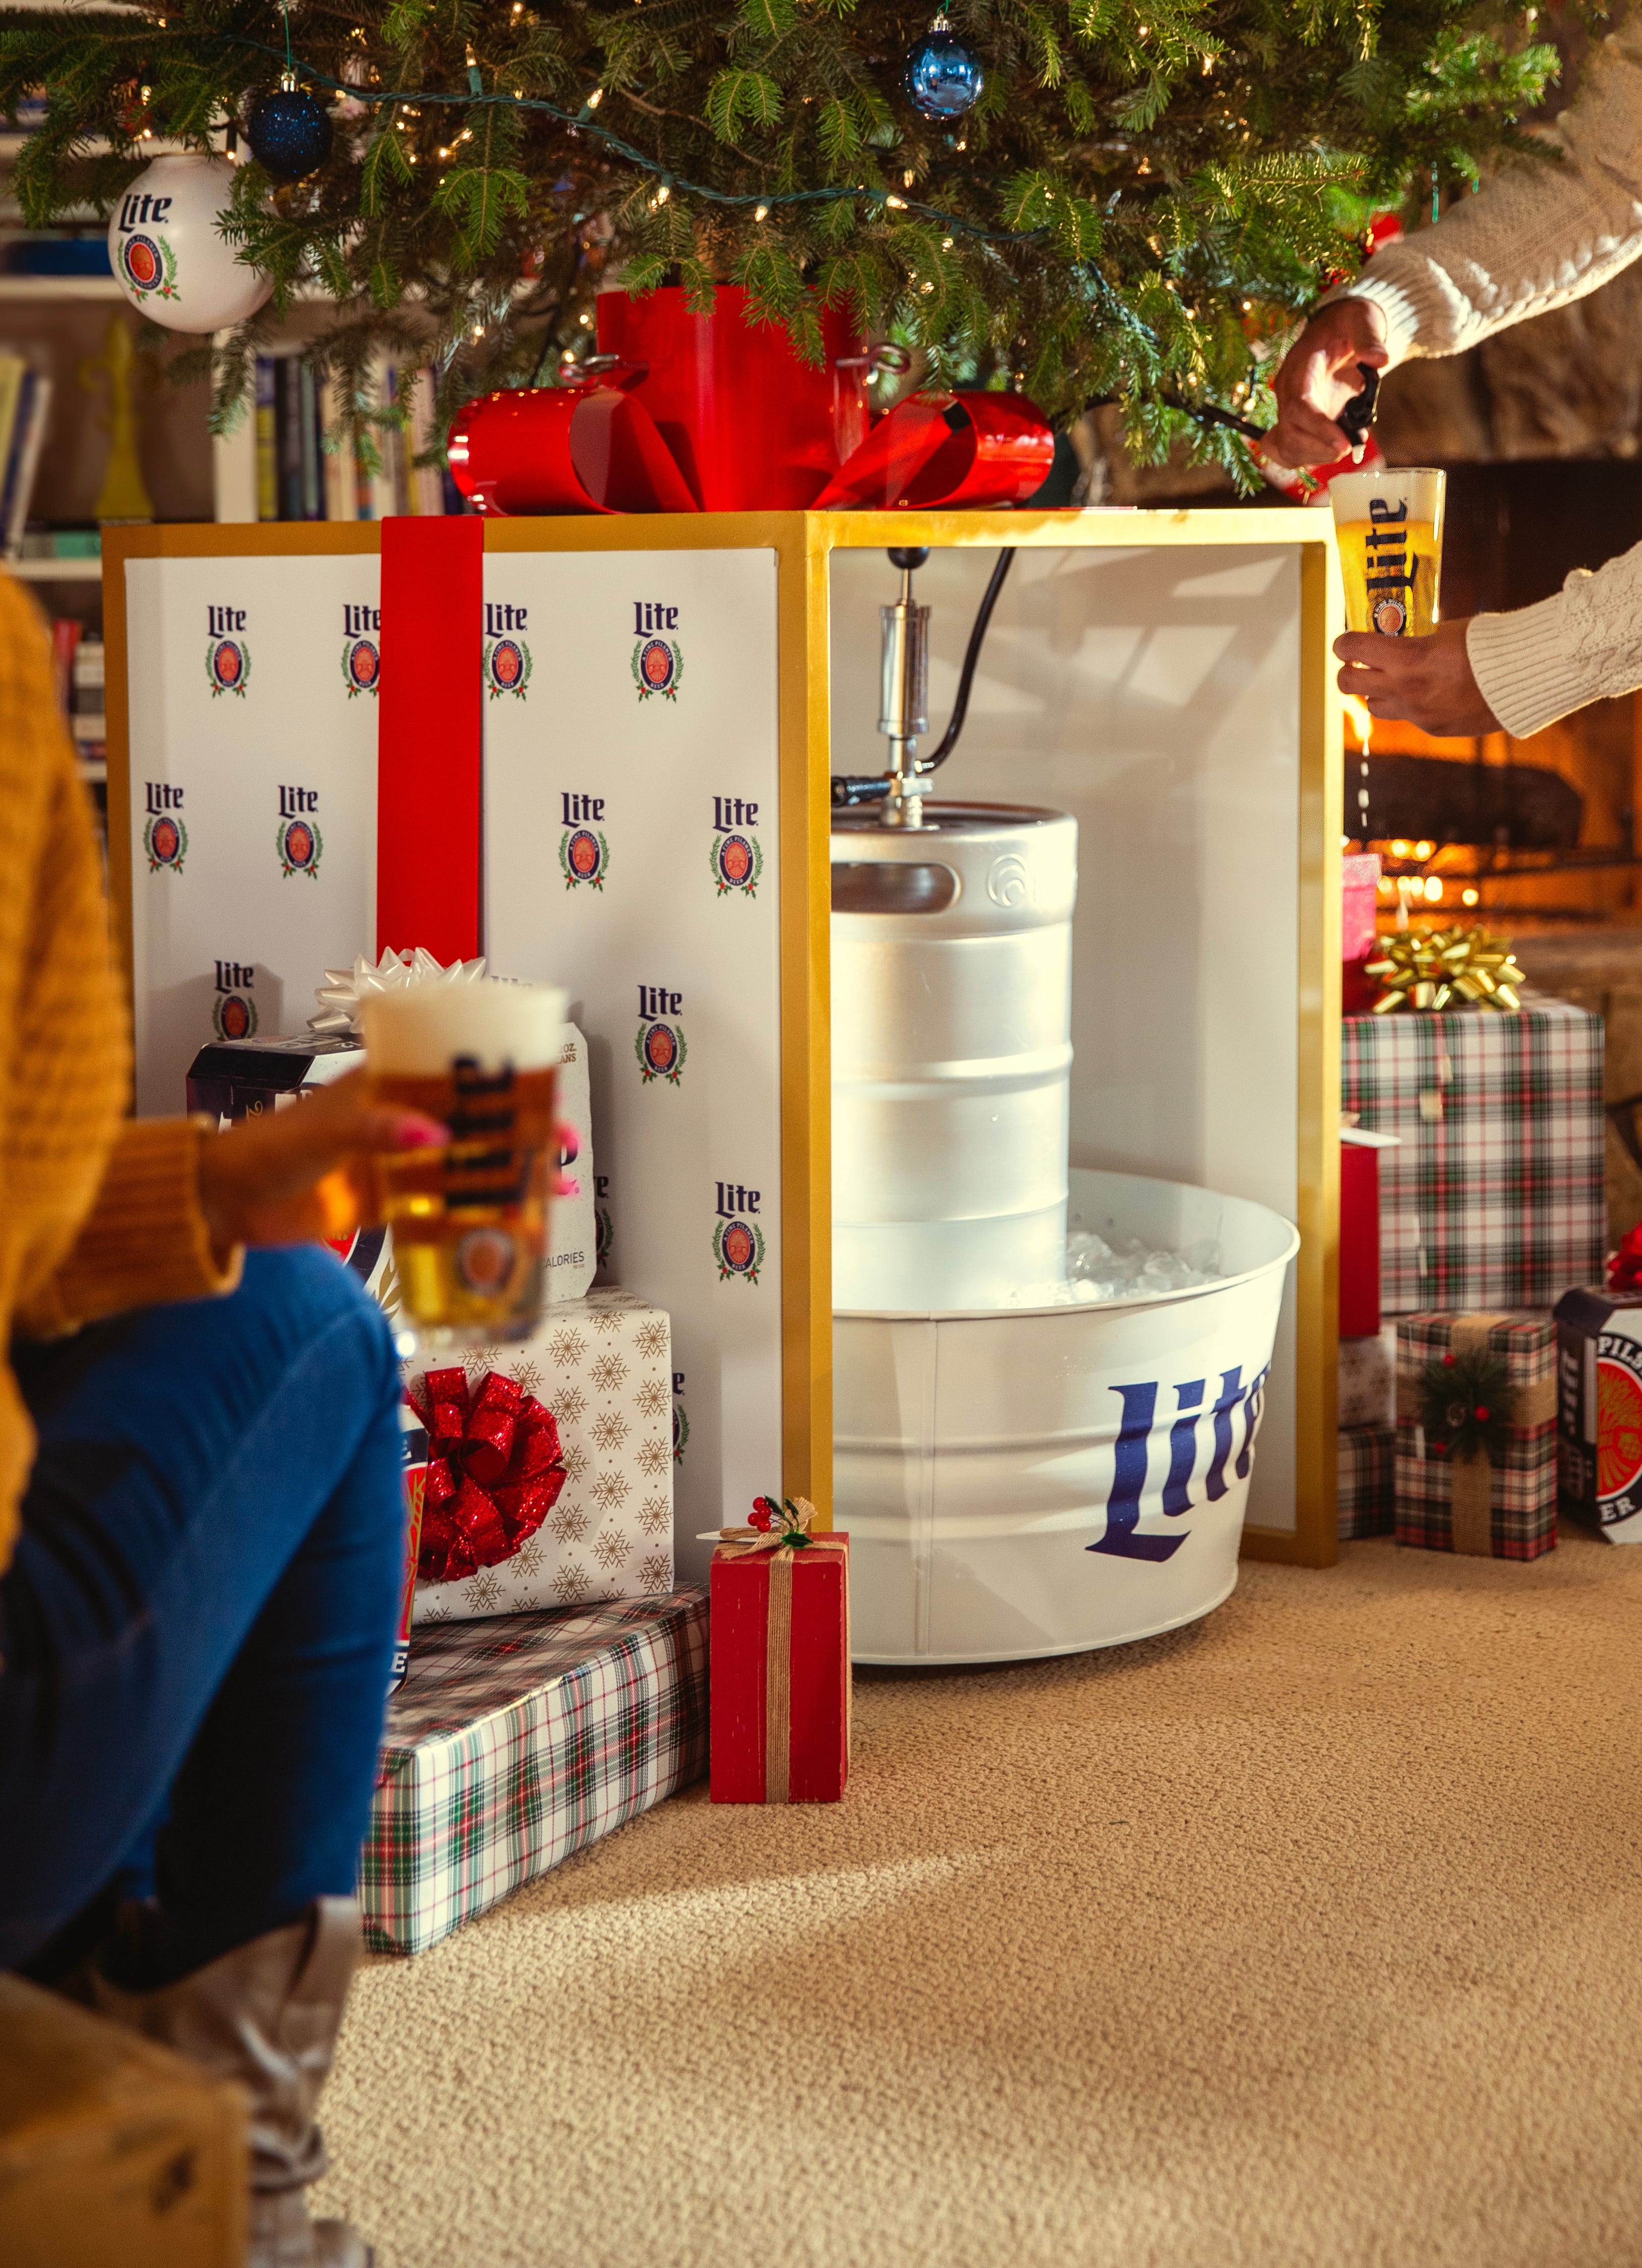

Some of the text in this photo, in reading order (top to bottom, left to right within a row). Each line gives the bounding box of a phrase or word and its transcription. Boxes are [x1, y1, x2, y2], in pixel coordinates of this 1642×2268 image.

[119, 193, 172, 233] Lite
[1366, 497, 1418, 592] Lite
[208, 606, 246, 639] Lite
[343, 605, 380, 639] Lite
[485, 604, 527, 639] Lite
[633, 602, 678, 638] Lite
[145, 782, 184, 816] Lite
[279, 786, 318, 819] Lite
[561, 792, 605, 828] Lite
[713, 796, 758, 833] Lite
[214, 961, 254, 995] Lite
[637, 985, 682, 1022] Lite
[560, 1053, 576, 1063] ANS
[715, 1181, 760, 1219] Lite
[546, 1251, 584, 1268] ALORIES
